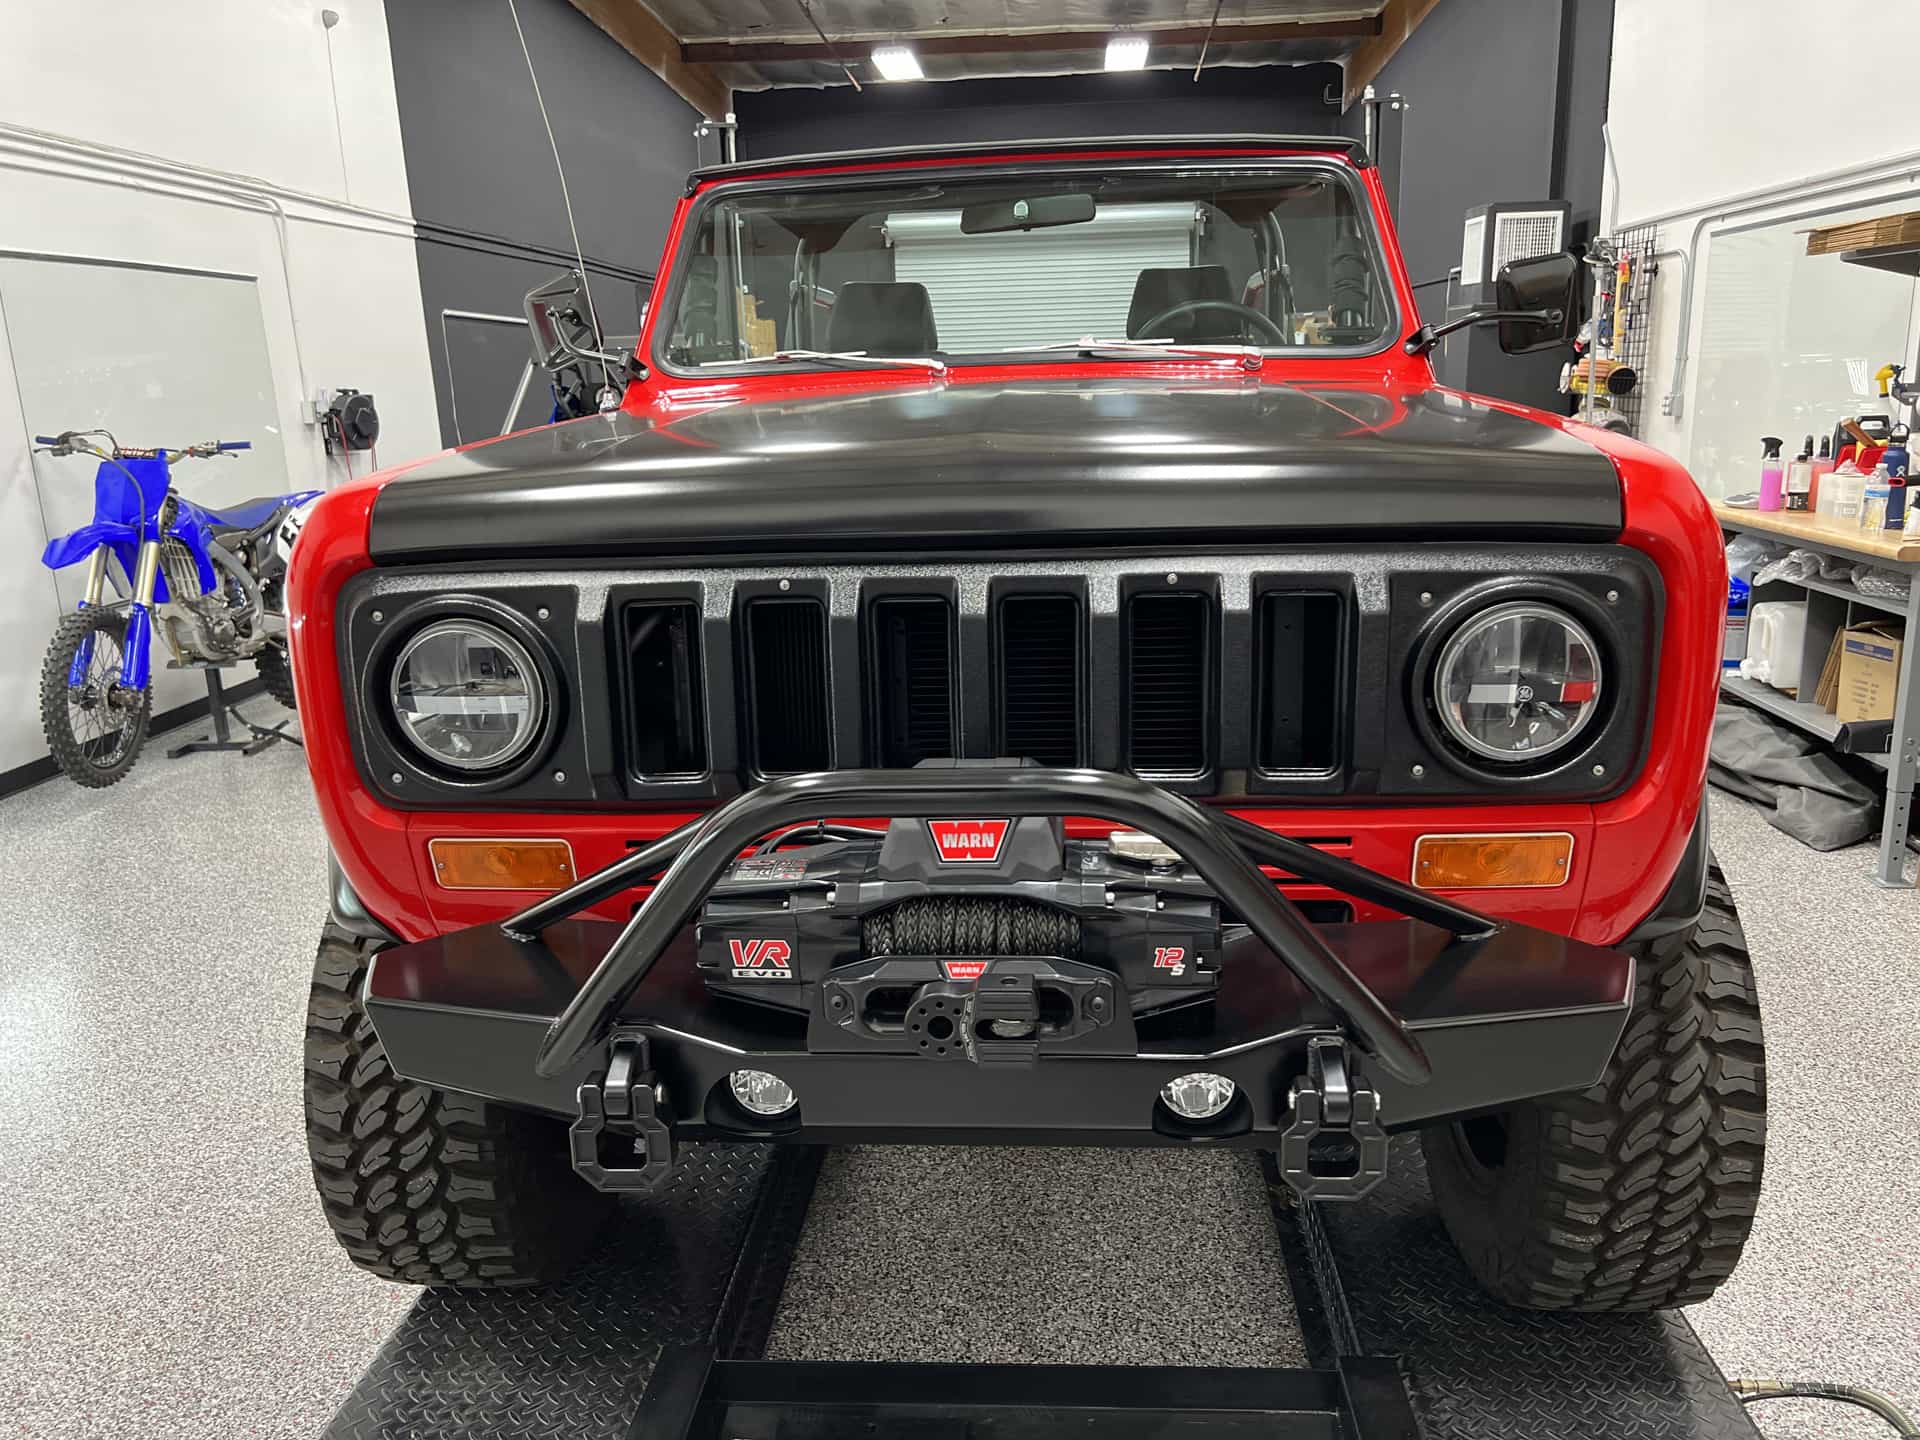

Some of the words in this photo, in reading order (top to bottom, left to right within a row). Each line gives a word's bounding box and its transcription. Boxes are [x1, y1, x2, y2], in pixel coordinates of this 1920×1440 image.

[942, 832, 995, 849] WARN
[729, 939, 792, 968] VR
[1153, 947, 1185, 968] 12
[736, 969, 788, 977] EVO
[951, 966, 980, 974] WARN
